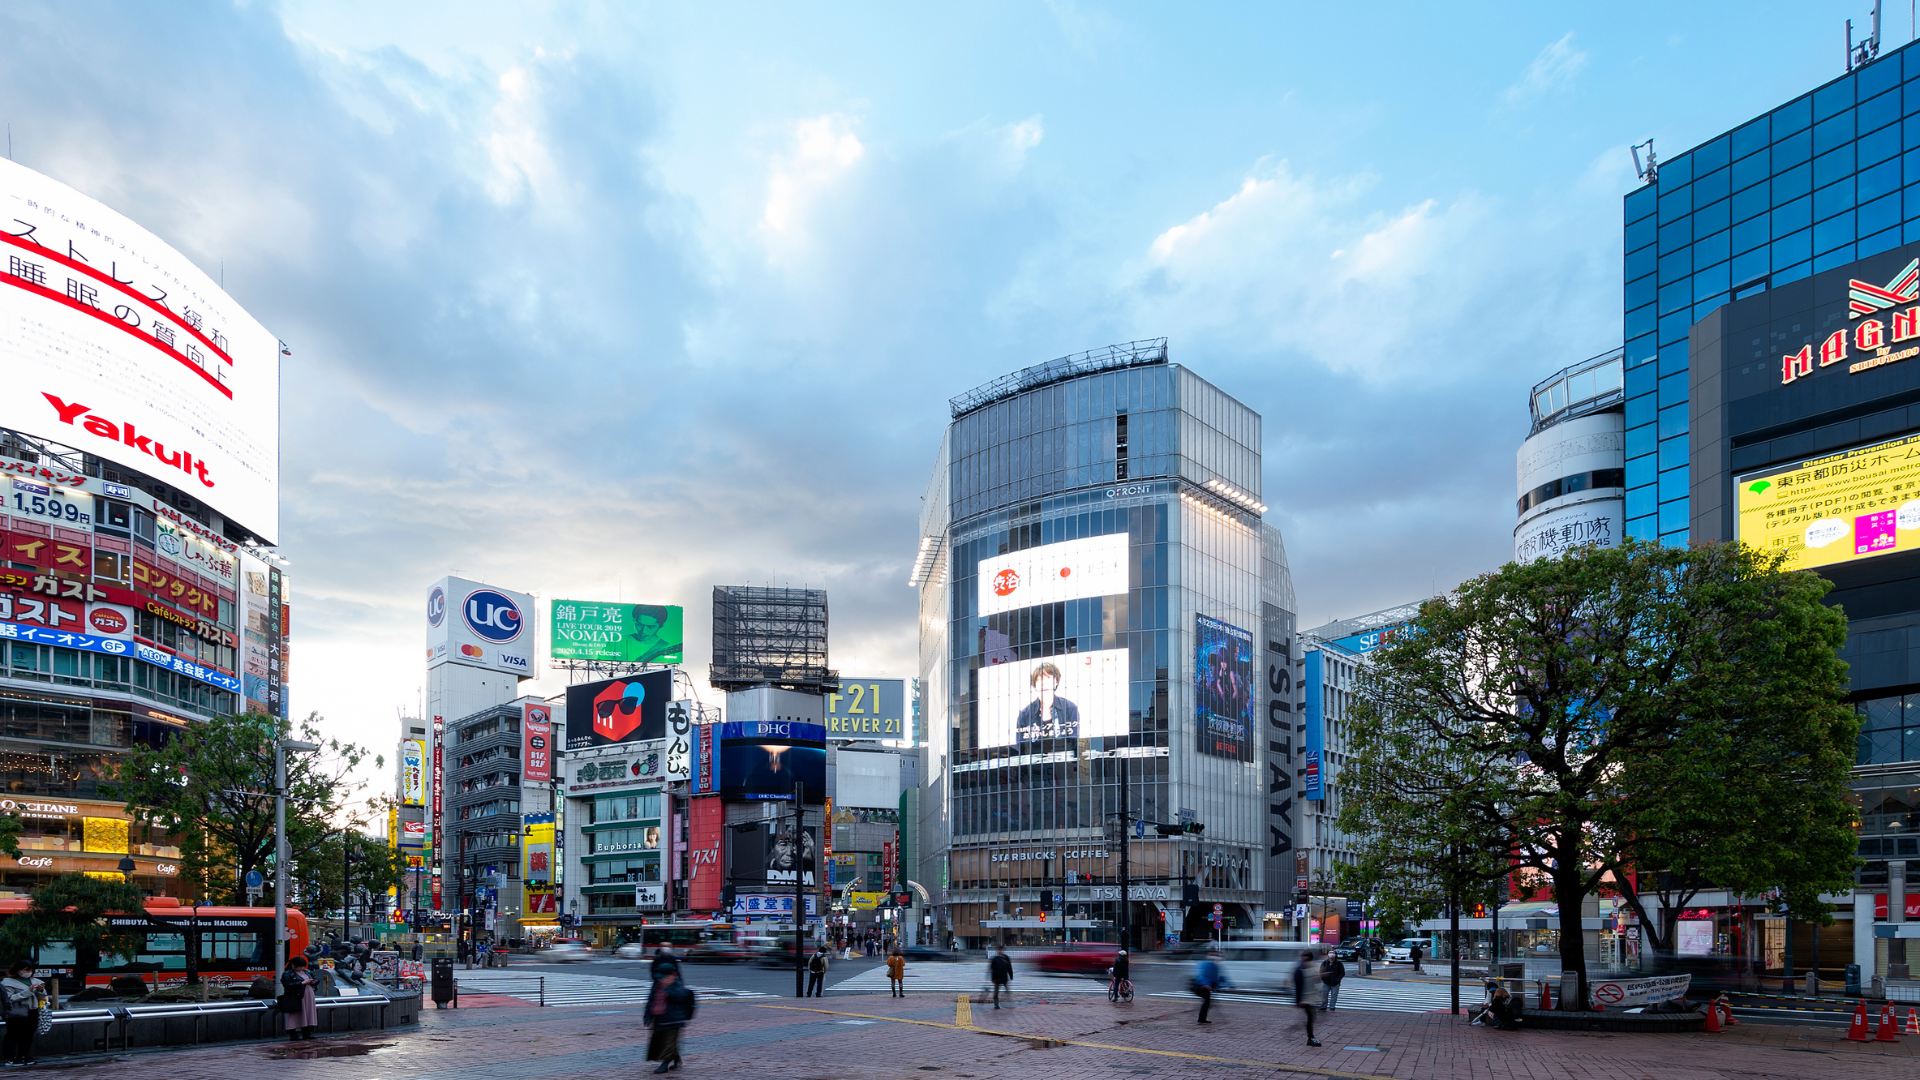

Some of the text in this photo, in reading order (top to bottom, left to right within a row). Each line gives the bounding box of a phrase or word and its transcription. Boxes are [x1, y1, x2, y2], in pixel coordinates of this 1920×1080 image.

[9, 218, 228, 356] ストレス緩和
[9, 254, 228, 391] 睡眠の質向上
[1782, 305, 1920, 385] MAGN
[1876, 346, 1892, 357] by
[1850, 347, 1919, 374] SHIBUYA109
[40, 391, 215, 487] Yakult
[1802, 453, 1846, 469] Disaster
[1847, 439, 1905, 458] Prevention
[1106, 485, 1151, 500] QFRONT
[1766, 480, 1920, 520] 各種冊子(PDF)の閲覧、東京
[13, 492, 90, 524] 1,599円
[153, 499, 238, 553] しゃぶしゃぶバイキング
[185, 540, 233, 579] しゃぶ葉
[33, 575, 107, 602] ガスト
[133, 562, 214, 611] コンタクト
[429, 595, 444, 618] UC
[469, 599, 519, 631] UC
[556, 604, 622, 624] 錦戸亮
[94, 617, 123, 628] ガスト
[197, 620, 232, 646] ガスト
[578, 623, 603, 631] TOUR
[105, 642, 122, 651] 6F
[557, 629, 622, 643] NOMAD
[437, 644, 446, 653] VISA
[500, 654, 527, 667] VISA
[556, 648, 622, 657] 2020.4.15 release
[143, 649, 239, 689] AEON 英会話イーオン
[829, 683, 880, 715] F21
[757, 724, 790, 735] DHC
[884, 718, 900, 733] 21
[667, 701, 689, 778] もんじゃ
[1216, 741, 1236, 754] NETFLIX
[1269, 636, 1292, 858] TSUTAYA
[699, 726, 710, 789] 三千里薬品
[1306, 750, 1319, 793] SEIBU
[597, 842, 642, 852] Euphoria
[992, 849, 1110, 862] STARBUCKS COFFEE
[18, 856, 53, 868] Café
[157, 864, 176, 874] Café
[530, 851, 548, 871] 薬
[691, 840, 719, 879] クスリ
[1204, 855, 1250, 869] TSUTAYA
[111, 918, 148, 926] SHIBUYA
[197, 919, 212, 928] bus
[213, 920, 248, 928] HACHIKO
